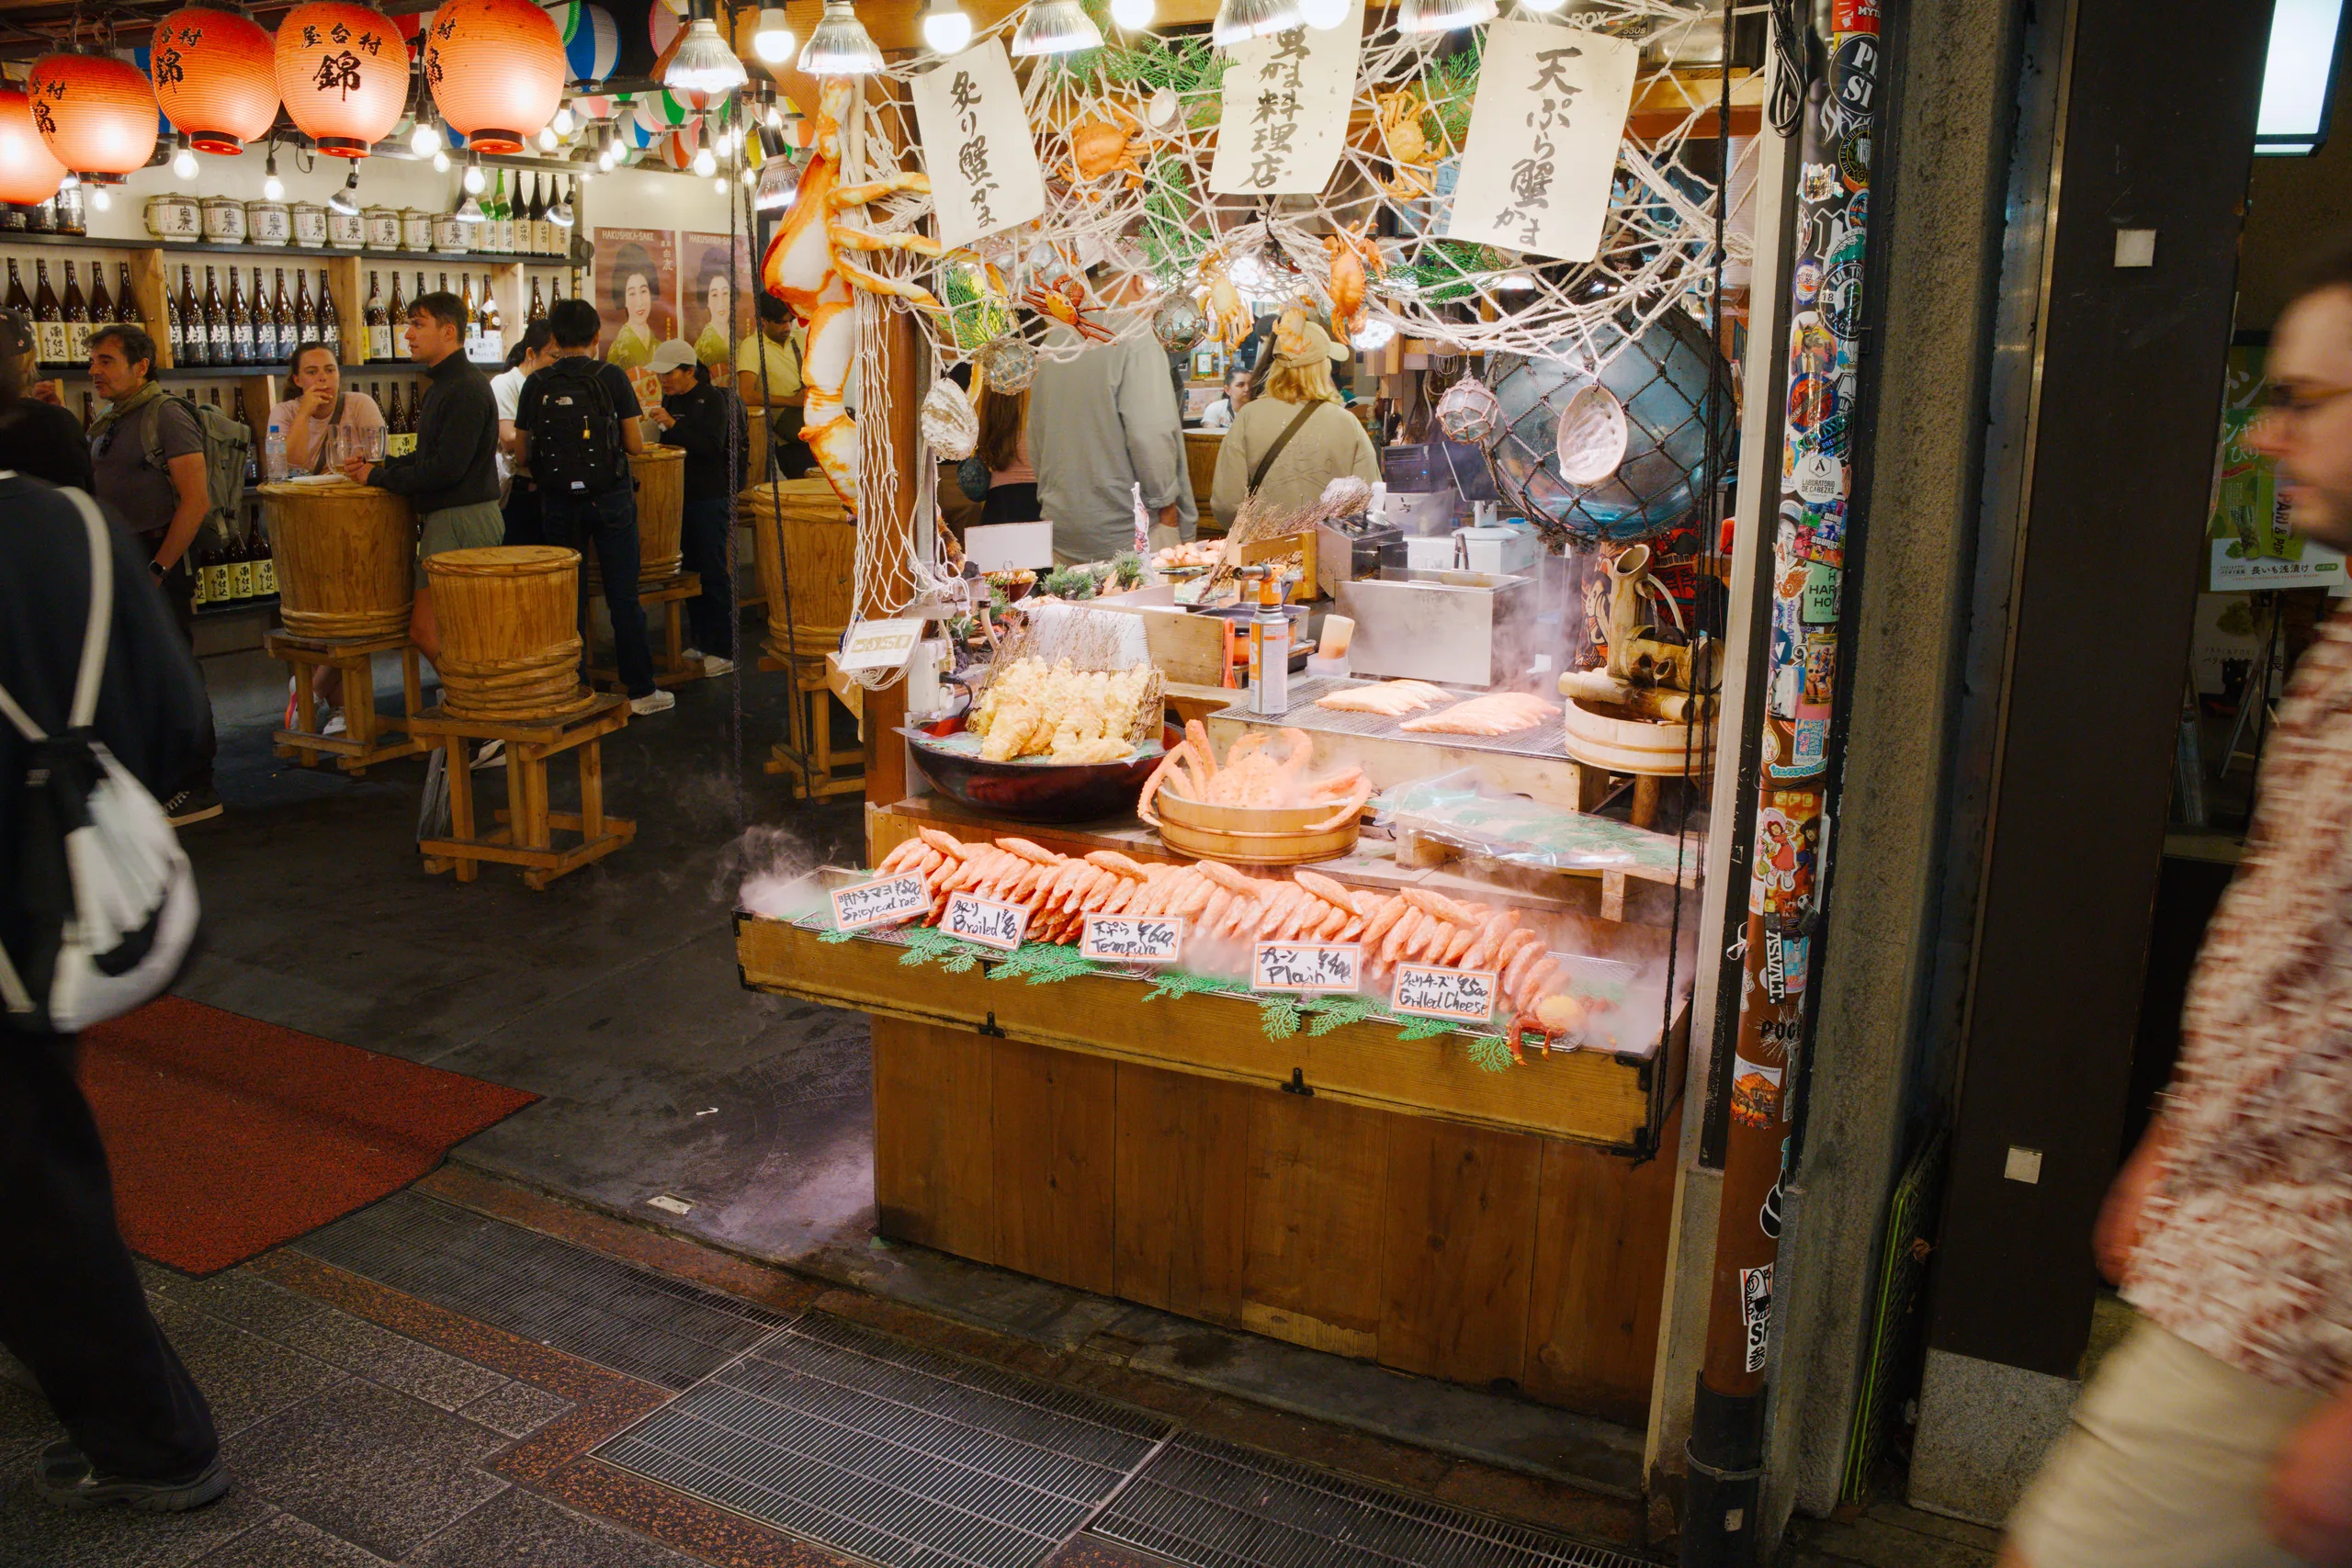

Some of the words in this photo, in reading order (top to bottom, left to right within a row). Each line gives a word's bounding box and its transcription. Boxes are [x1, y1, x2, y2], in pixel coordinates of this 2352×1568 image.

[301, 22, 382, 57] 屋台村
[312, 50, 362, 102] 錦
[950, 70, 1001, 229] 炙り蟹かま
[1493, 47, 1584, 247] 天ぷら蟹かま
[602, 230, 655, 242] HAKUSHIKA-SAKE
[1802, 479, 1836, 488] LABORATORIO
[1809, 486, 1835, 494] CABEZAS
[2251, 564, 2309, 576] 長いも浅漬け
[953, 910, 999, 937] Broiled
[1266, 965, 1327, 986] Plain
[1399, 988, 1442, 1010] Grilled
[1443, 990, 1488, 1015] Cheese
